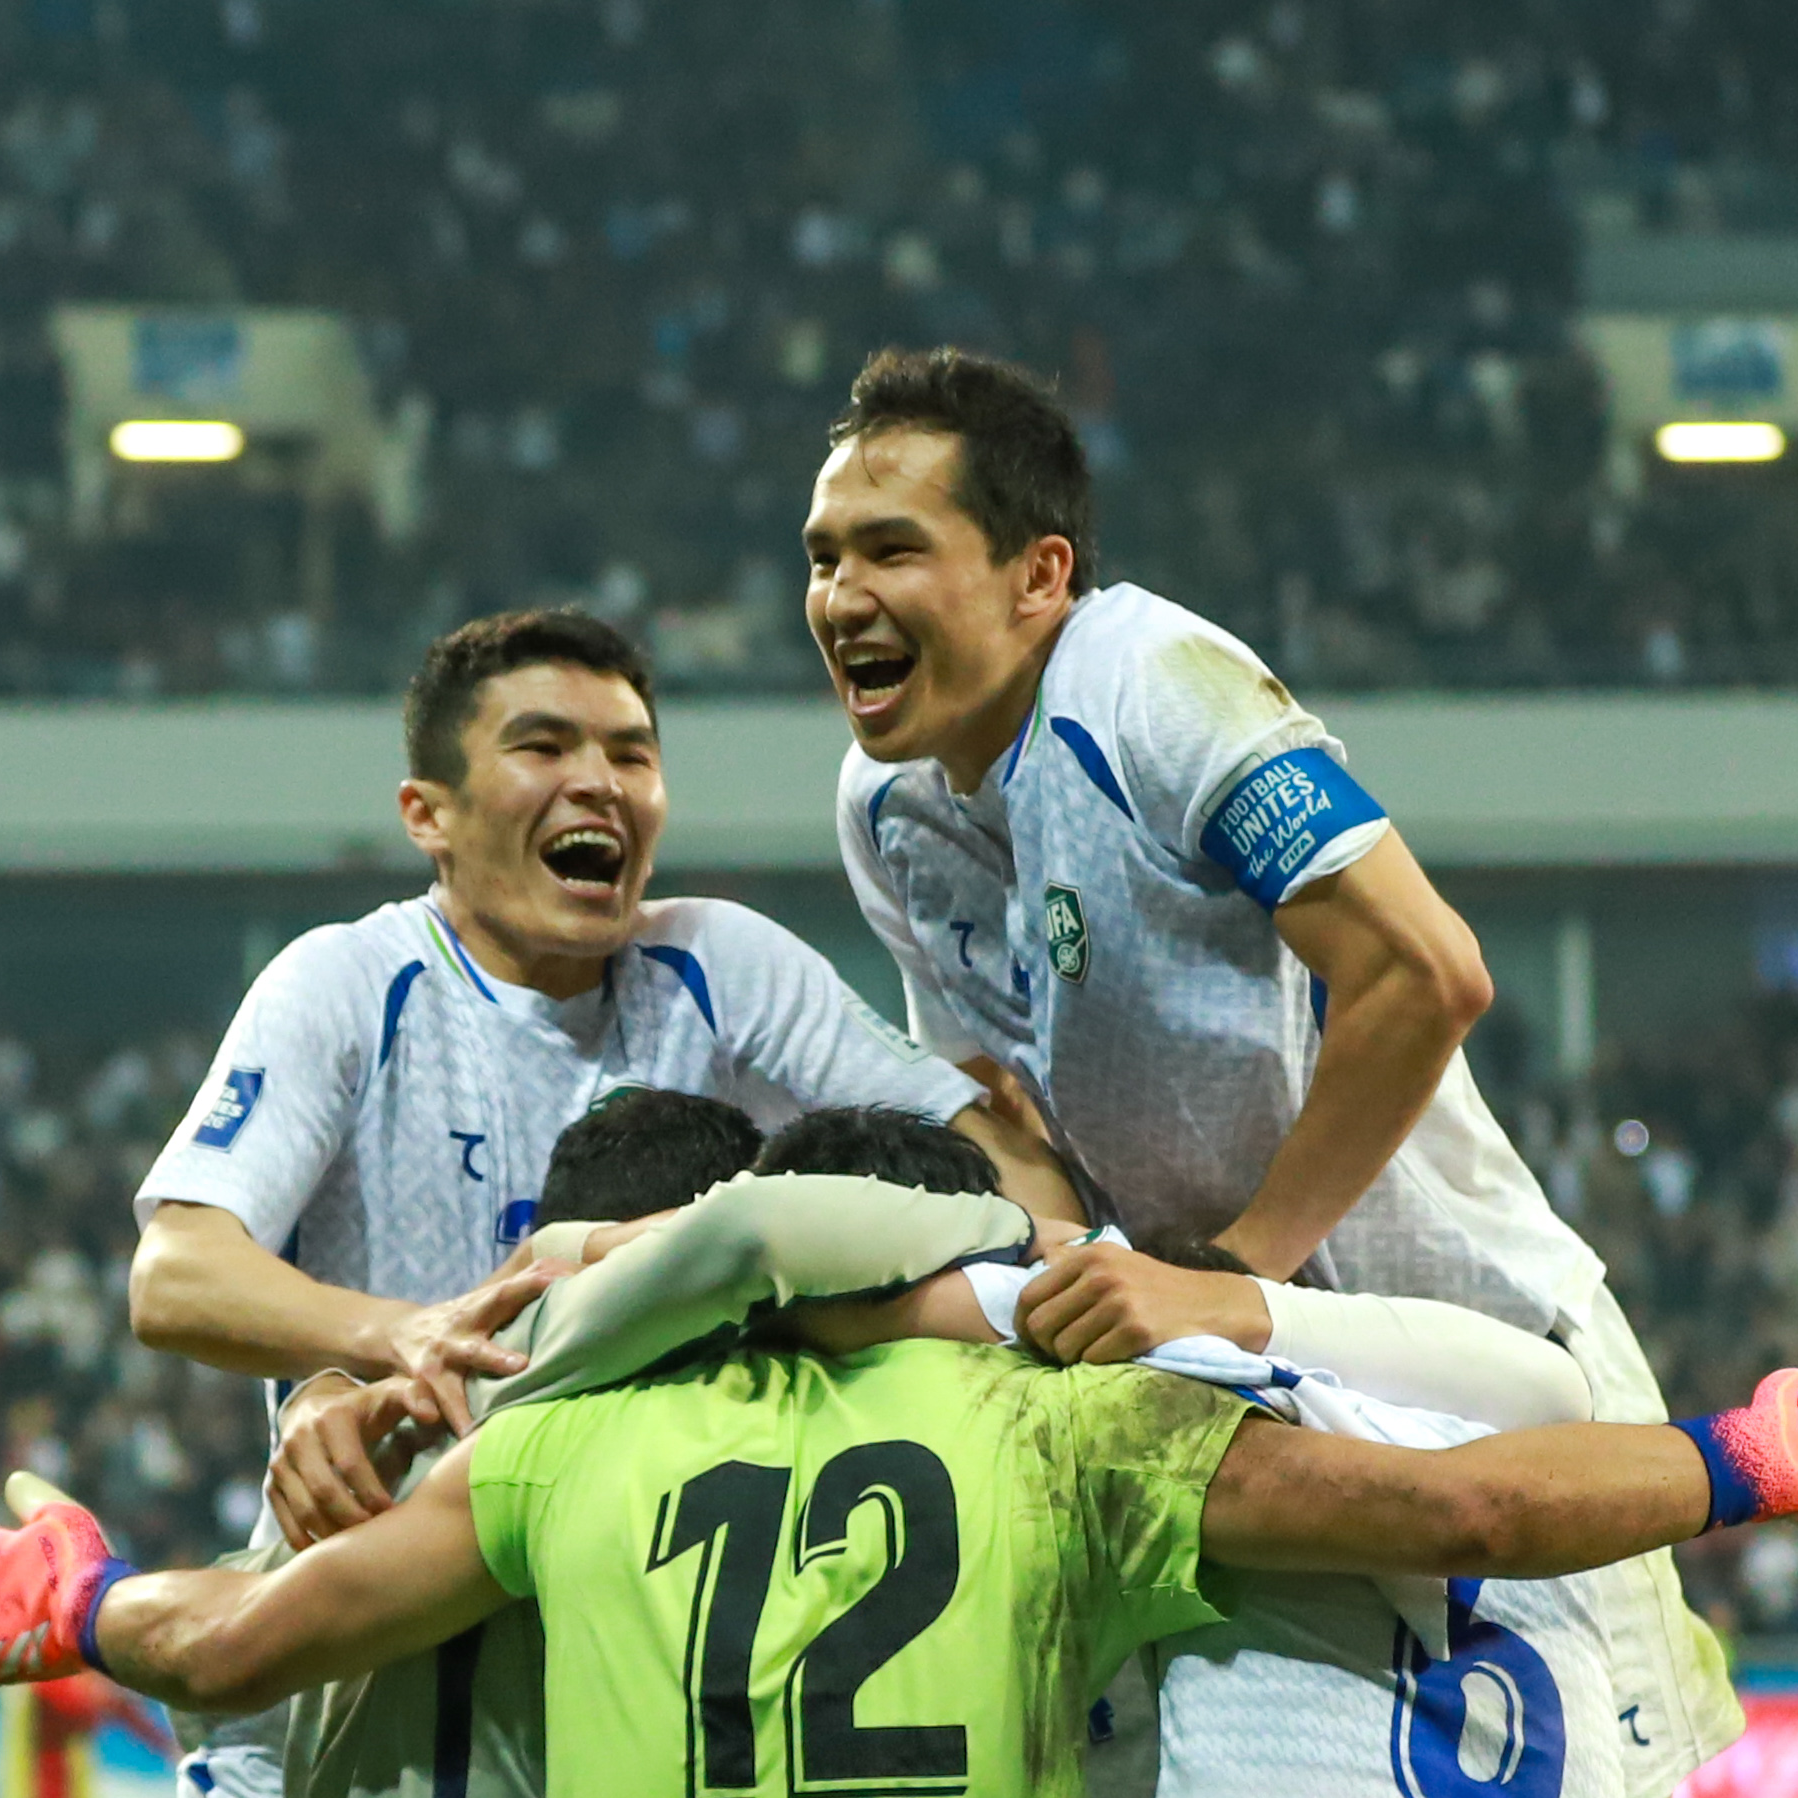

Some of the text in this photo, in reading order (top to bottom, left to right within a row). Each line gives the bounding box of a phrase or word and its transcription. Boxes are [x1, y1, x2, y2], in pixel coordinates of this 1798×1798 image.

[1218, 760, 1301, 835] FOOTBALL
[1232, 772, 1315, 856] UNITES
[1248, 789, 1332, 879] the World
[1279, 831, 1315, 873] FIFA
